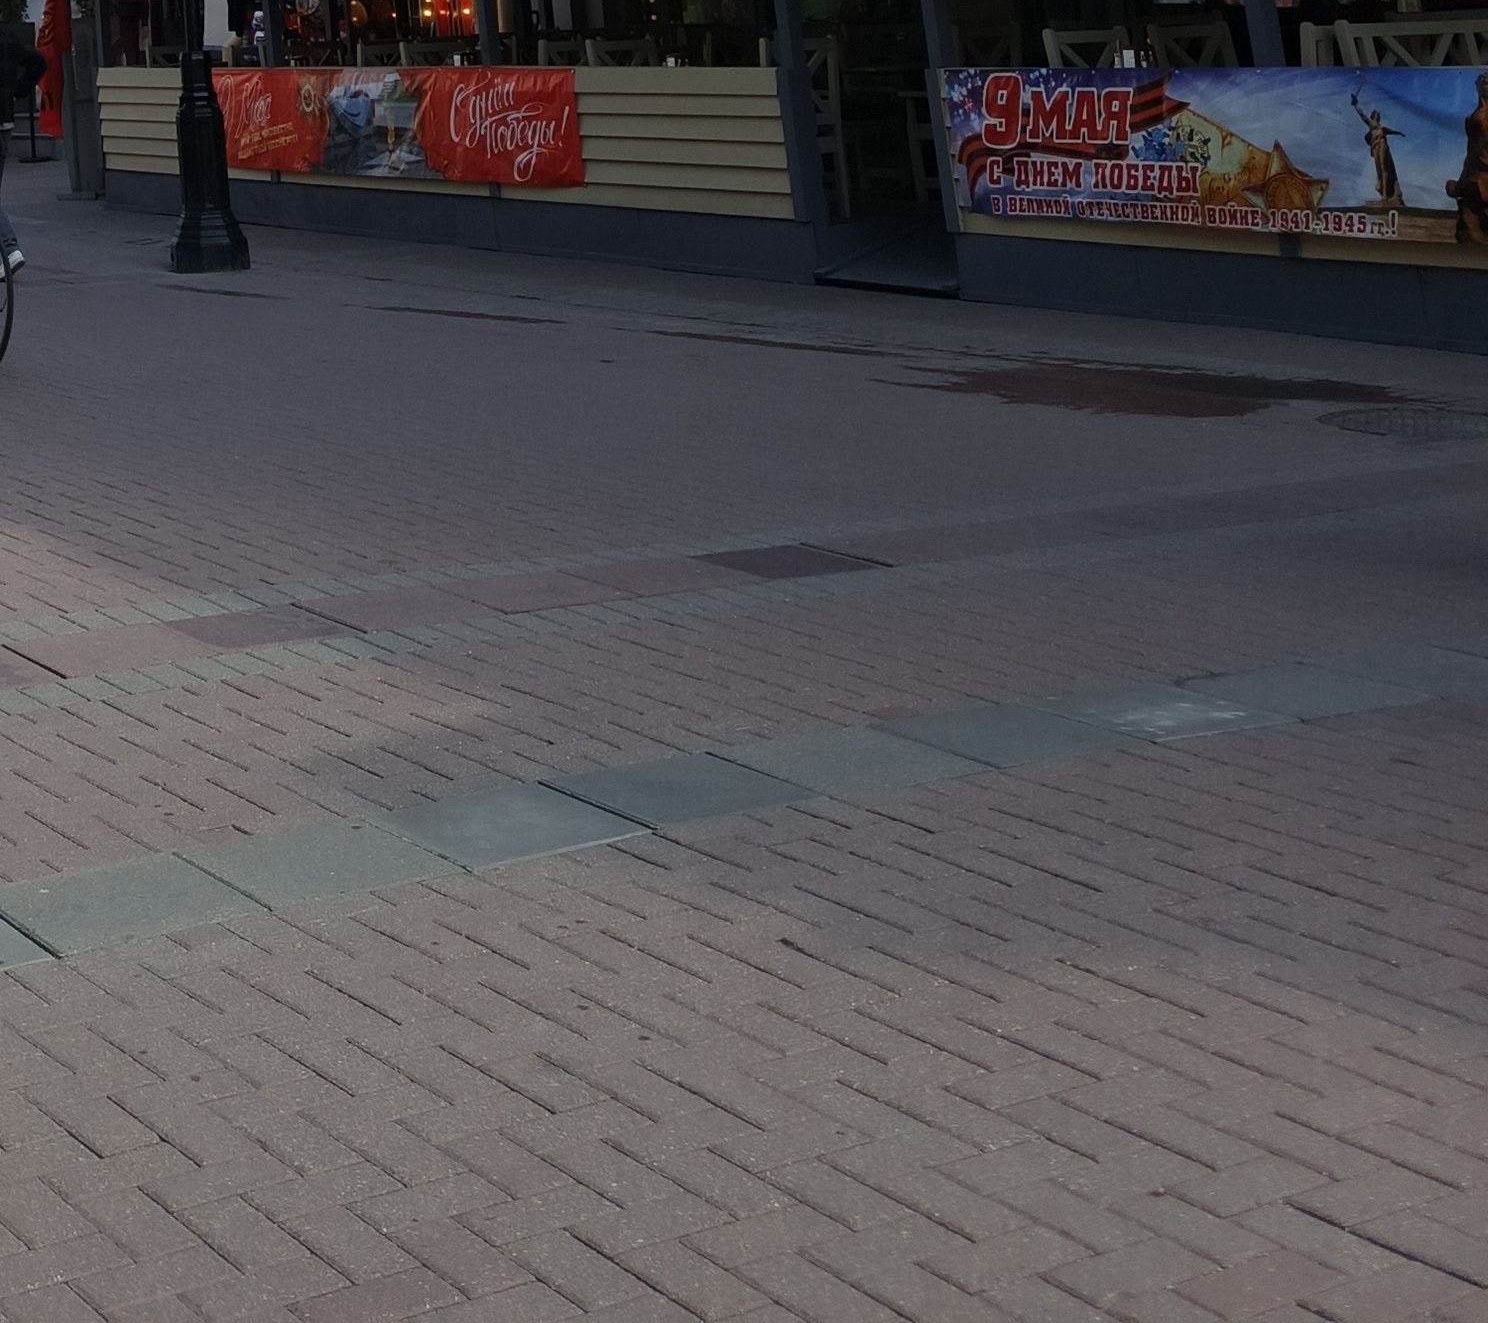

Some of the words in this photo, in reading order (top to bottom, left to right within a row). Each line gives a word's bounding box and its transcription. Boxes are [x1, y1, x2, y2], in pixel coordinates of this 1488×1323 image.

[983, 73, 1022, 148] 9
[1027, 87, 1133, 144] МАЯ
[987, 157, 1003, 187] С
[1015, 158, 1085, 191] ДНЕМ
[1092, 160, 1201, 196] ПОБЕДЫ
[991, 195, 1002, 215] В
[1006, 193, 1071, 217] ВЕЛИКОЙ
[1077, 200, 1202, 225] ОТЕЧЕСТВЕННОЙ
[1206, 203, 1261, 228] ВОЙНЕ
